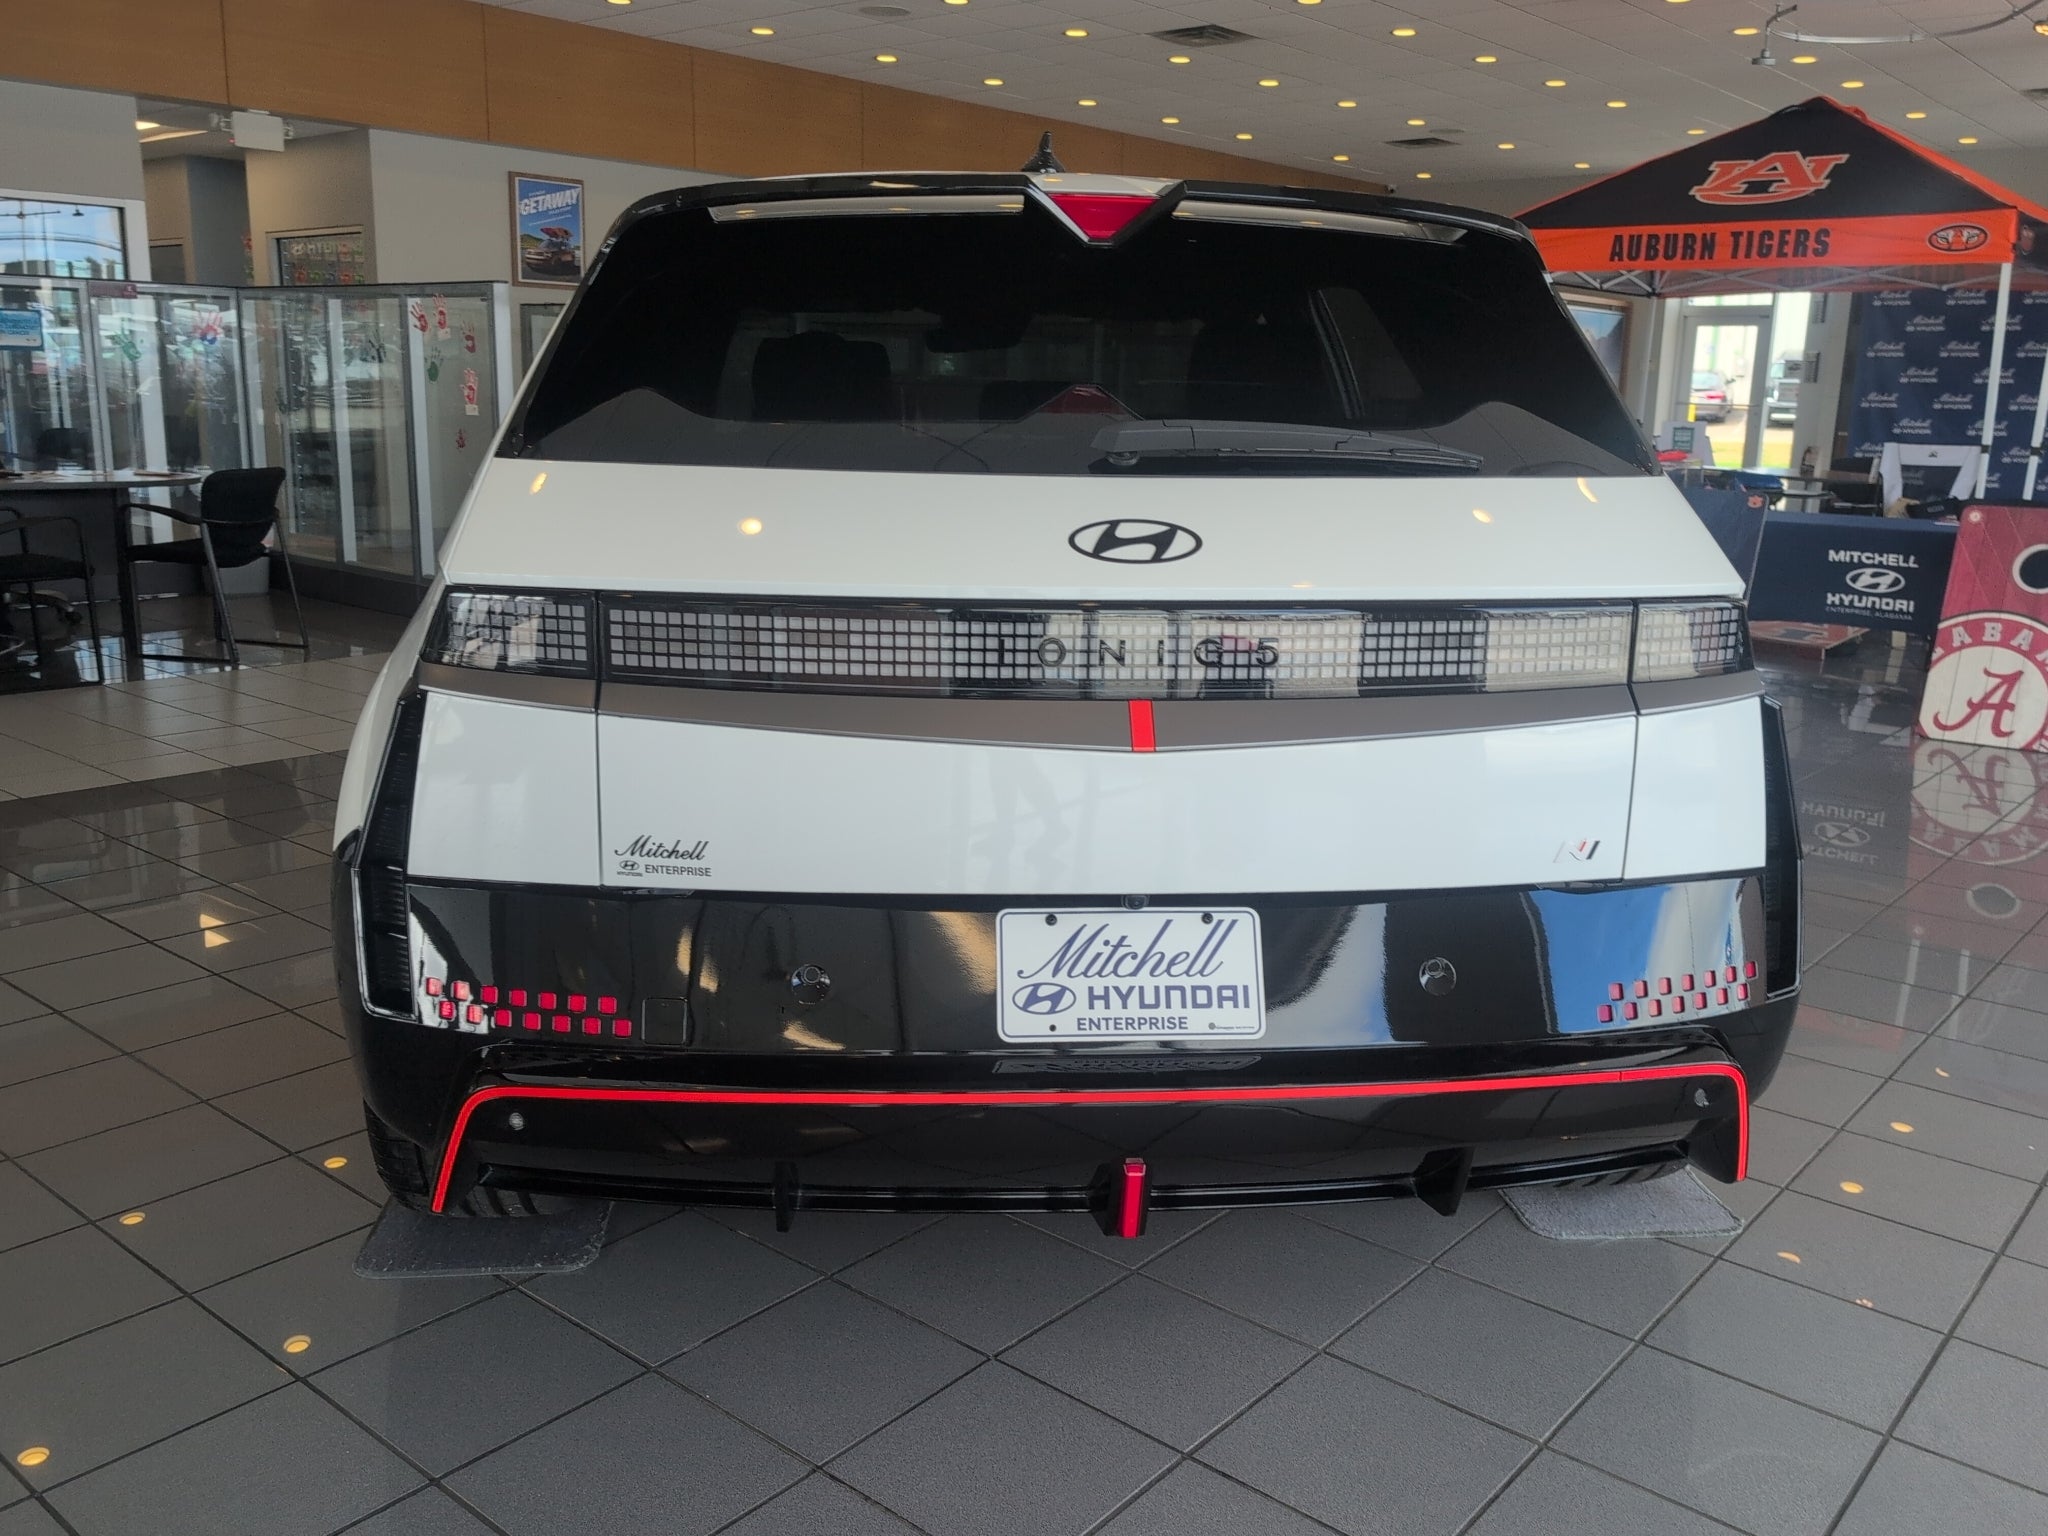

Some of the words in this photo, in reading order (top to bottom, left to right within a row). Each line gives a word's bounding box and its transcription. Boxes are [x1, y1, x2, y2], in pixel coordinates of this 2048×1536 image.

[520, 188, 581, 215] GETAWAY
[1609, 233, 1716, 262] AUBURN
[1731, 228, 1832, 259] TIGERS
[1827, 549, 1919, 569] MITCHELL
[1826, 592, 1915, 613] HYUNDAI
[1256, 637, 1280, 667] 5
[1933, 667, 2025, 738] A
[614, 834, 709, 861] Mitchell
[644, 864, 712, 877] ENTERPRISE
[1017, 918, 1239, 979] Mitchell
[1087, 984, 1251, 1011] HYUNDAI
[1076, 1015, 1189, 1032] ENTERPRISE
